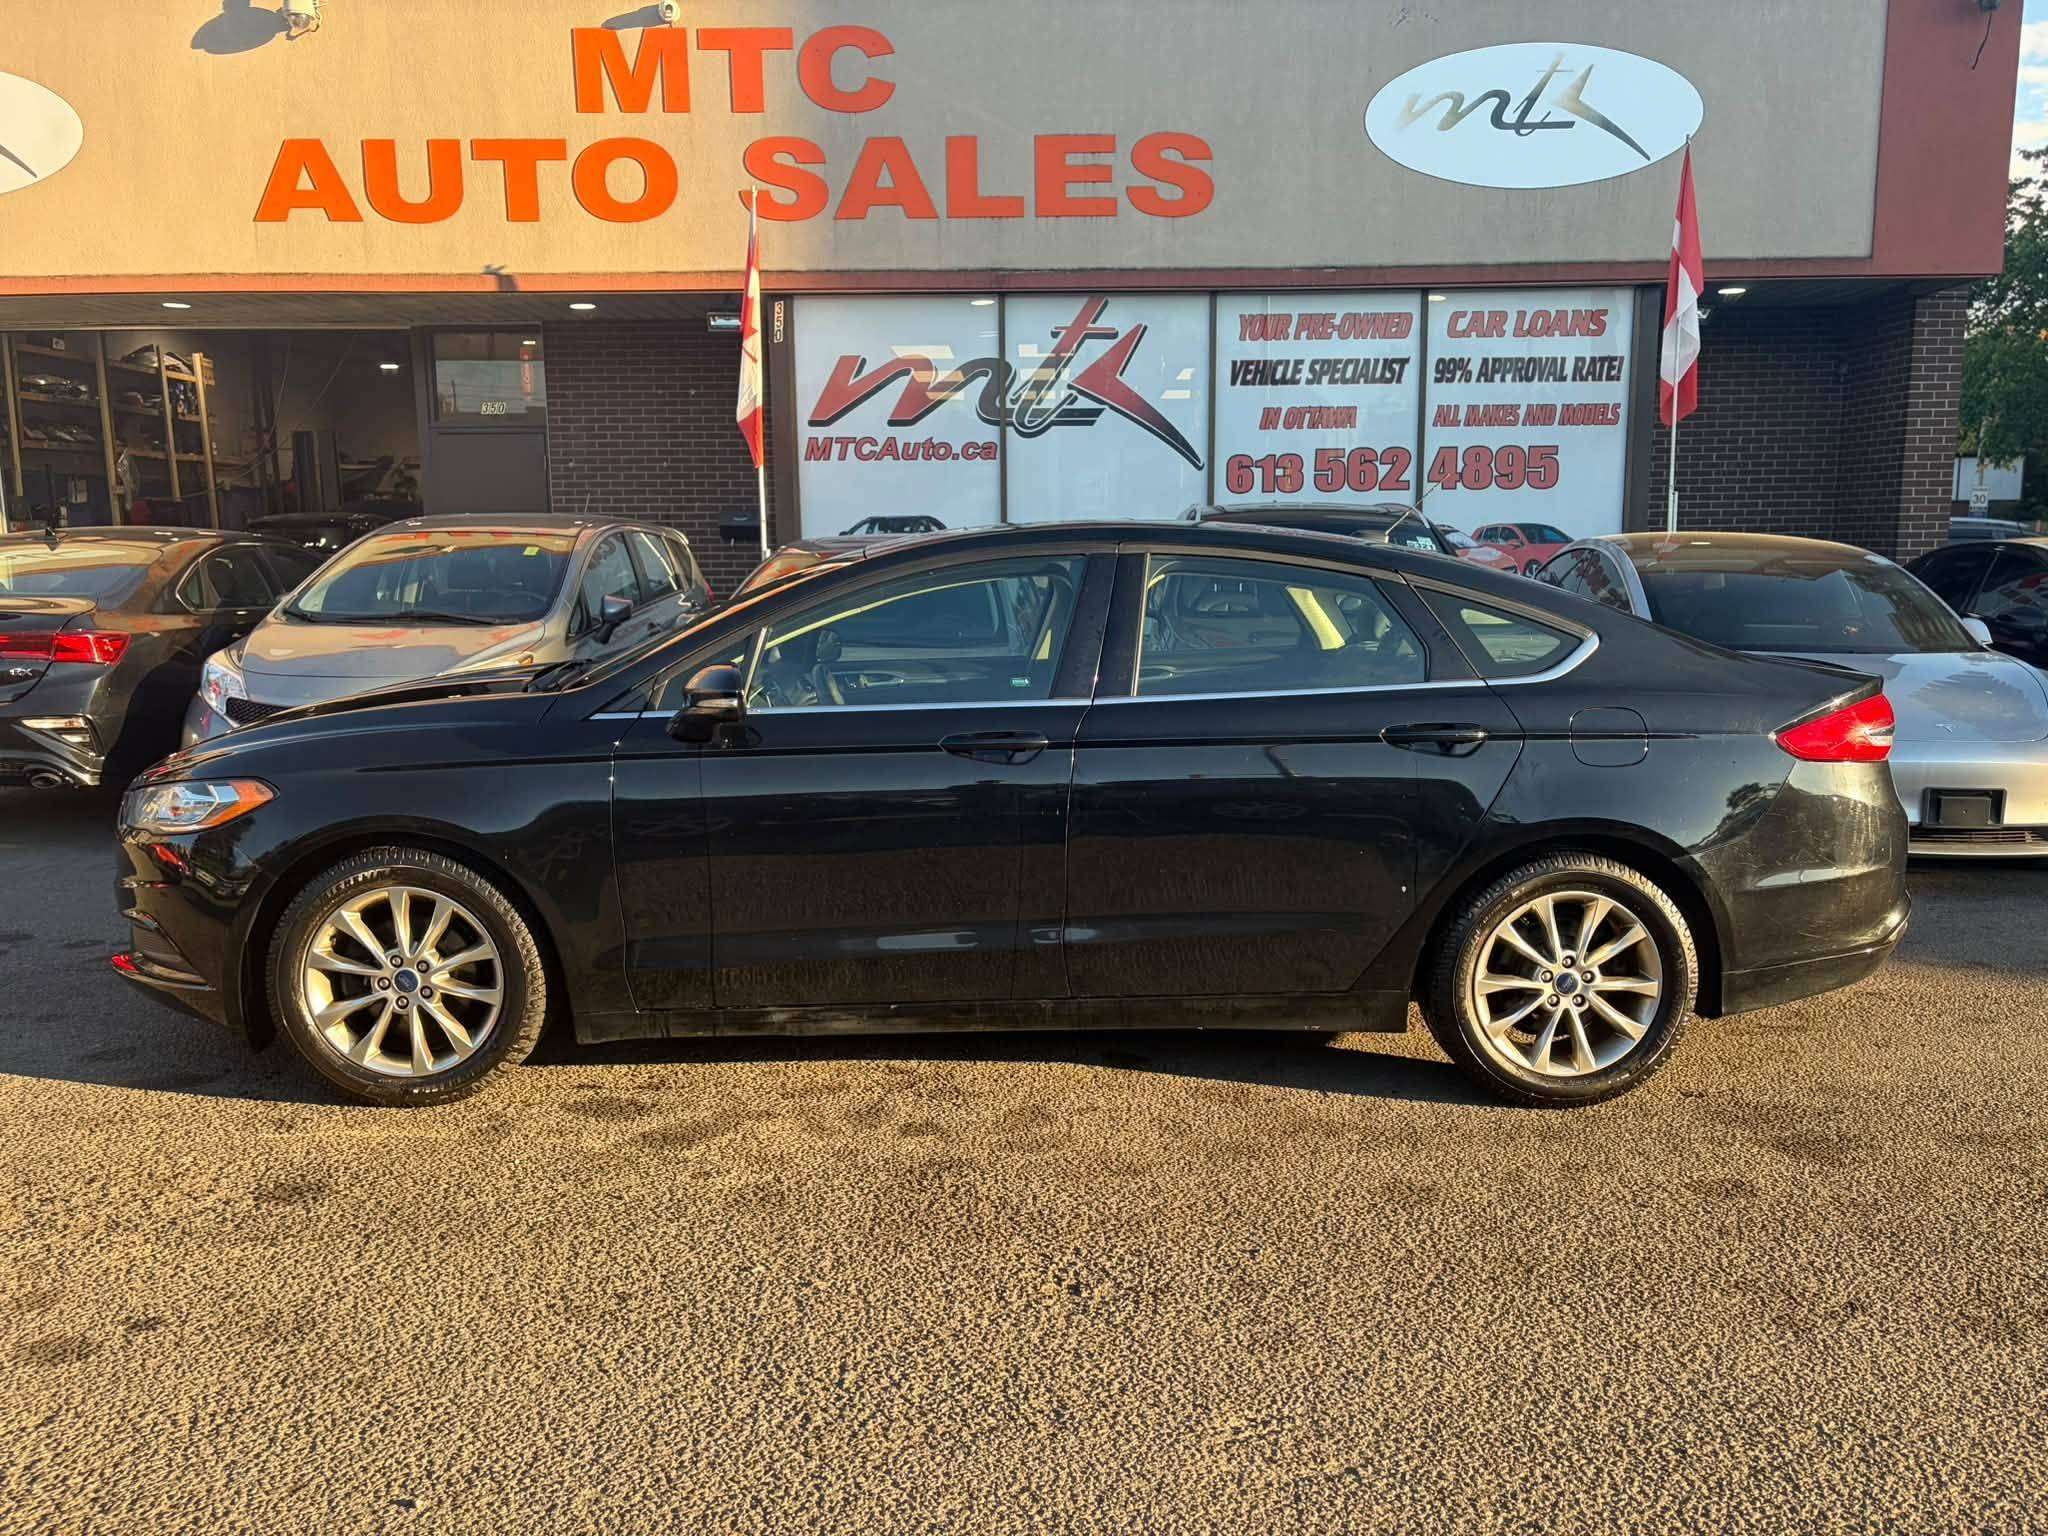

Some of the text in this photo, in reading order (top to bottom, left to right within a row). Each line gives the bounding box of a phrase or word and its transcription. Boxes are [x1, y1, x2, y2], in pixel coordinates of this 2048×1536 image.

[571, 25, 896, 114] MTC
[253, 131, 1216, 224] AUTO SALES
[774, 301, 784, 342] 350
[1239, 312, 1413, 341] YOUR PRE-OWNED
[1447, 309, 1609, 338] CAR LOANS
[1230, 356, 1411, 387] VEHICLE SPECIALIST
[1434, 355, 1625, 384] 99% APPROVAL RATE!
[1259, 405, 1358, 430] IN OTTAWA
[1432, 403, 1622, 427] ALL MAKES AND MODELS
[804, 436, 998, 461] MTCAuto.ca
[1226, 444, 1560, 494] 613 562 4895
[1972, 494, 1987, 505] 30
